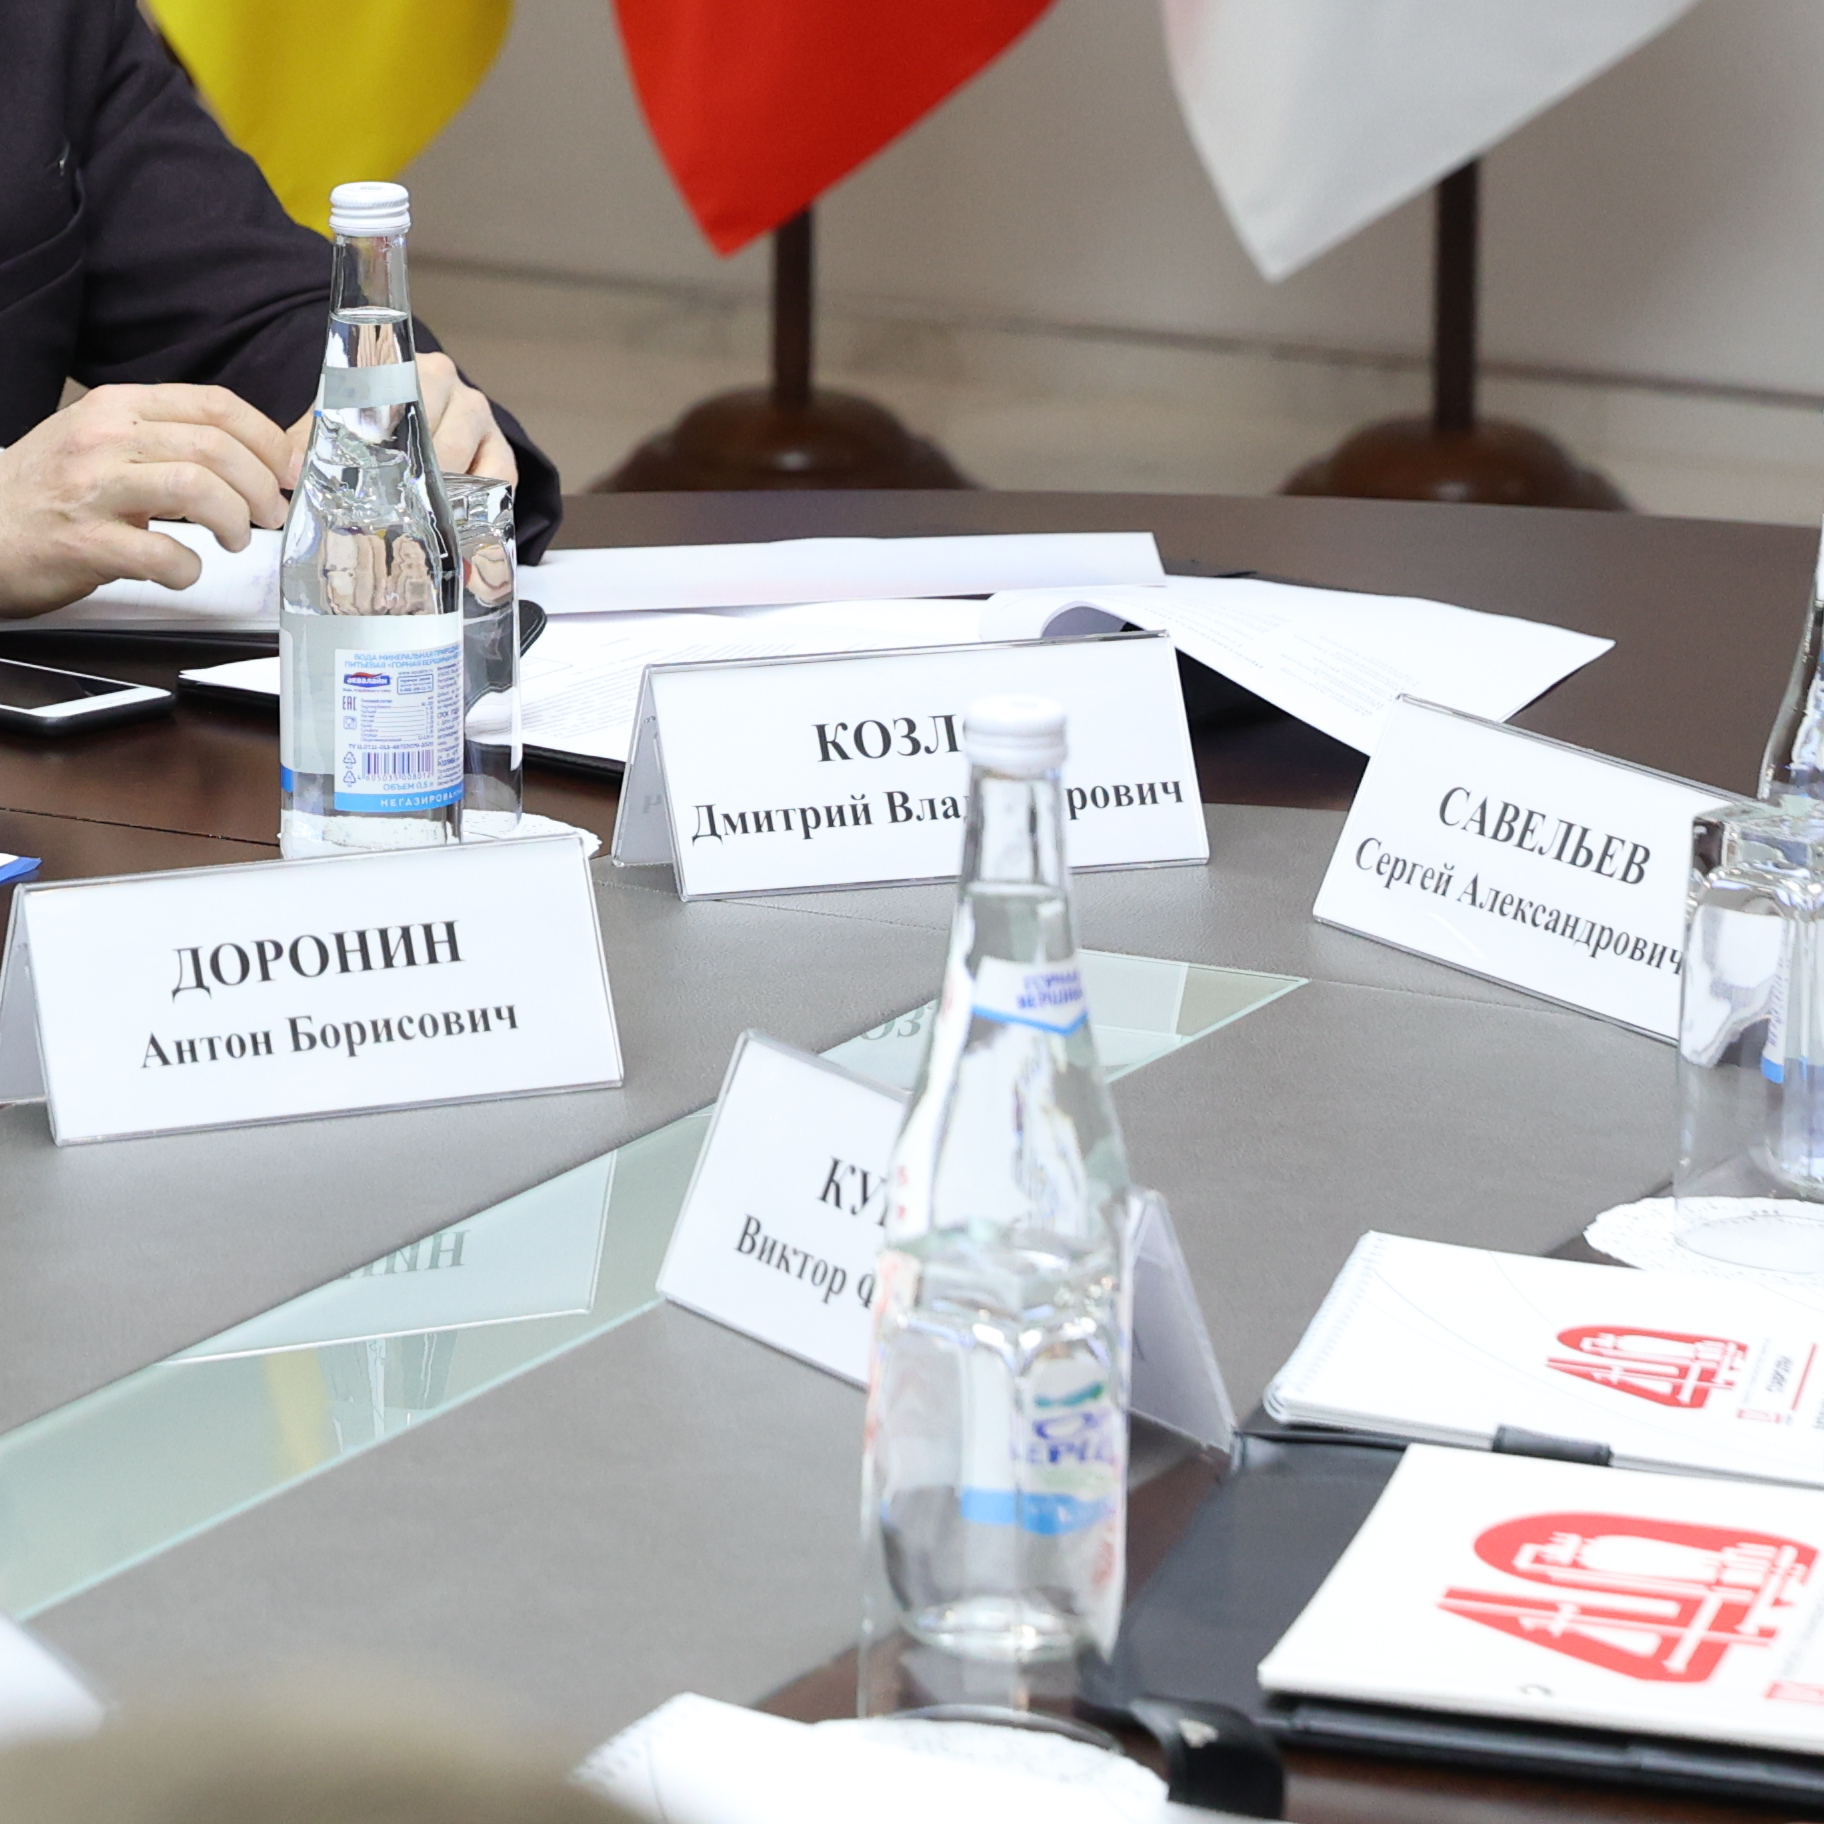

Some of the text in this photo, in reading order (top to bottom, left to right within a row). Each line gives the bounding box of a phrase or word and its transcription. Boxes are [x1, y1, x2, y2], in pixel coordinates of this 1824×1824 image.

[813, 713, 962, 763] КОЗЛ
[691, 779, 1184, 847] Дмитрий Вларович
[1438, 786, 1651, 885] САВЕЛЬЕВ
[1354, 837, 1684, 976] Сергей Александрович
[171, 920, 466, 1002] ДОРОНИН
[140, 1002, 520, 1070] Антон Борисович
[734, 1213, 848, 1305] Виктор
